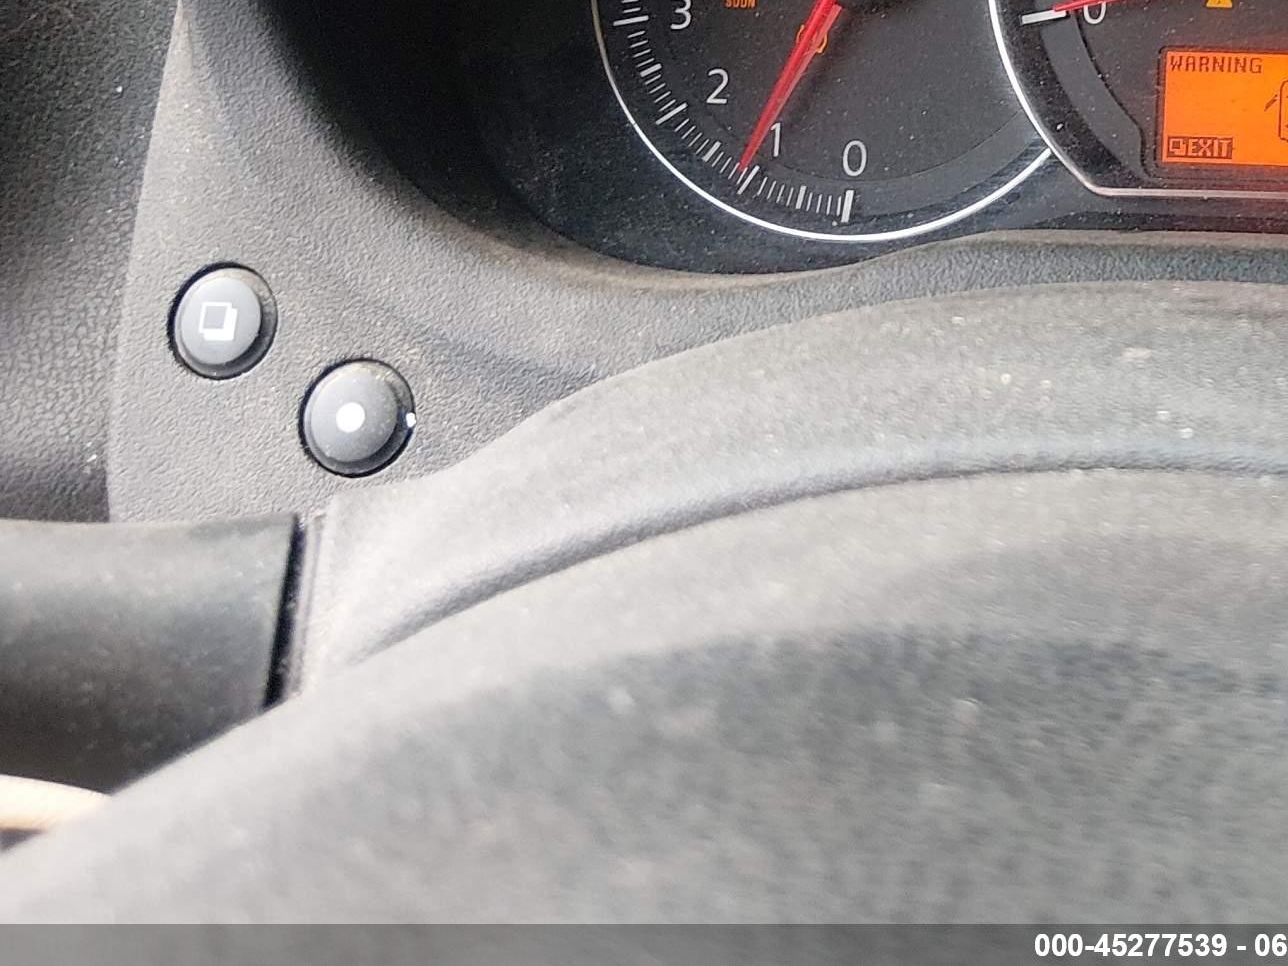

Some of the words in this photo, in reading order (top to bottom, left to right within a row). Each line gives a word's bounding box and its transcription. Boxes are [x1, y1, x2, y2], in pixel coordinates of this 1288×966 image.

[1170, 55, 1263, 74] WARNING
[707, 70, 728, 105] 2
[770, 123, 782, 157] 1
[1187, 138, 1233, 158] EXIT
[843, 141, 867, 176] 0
